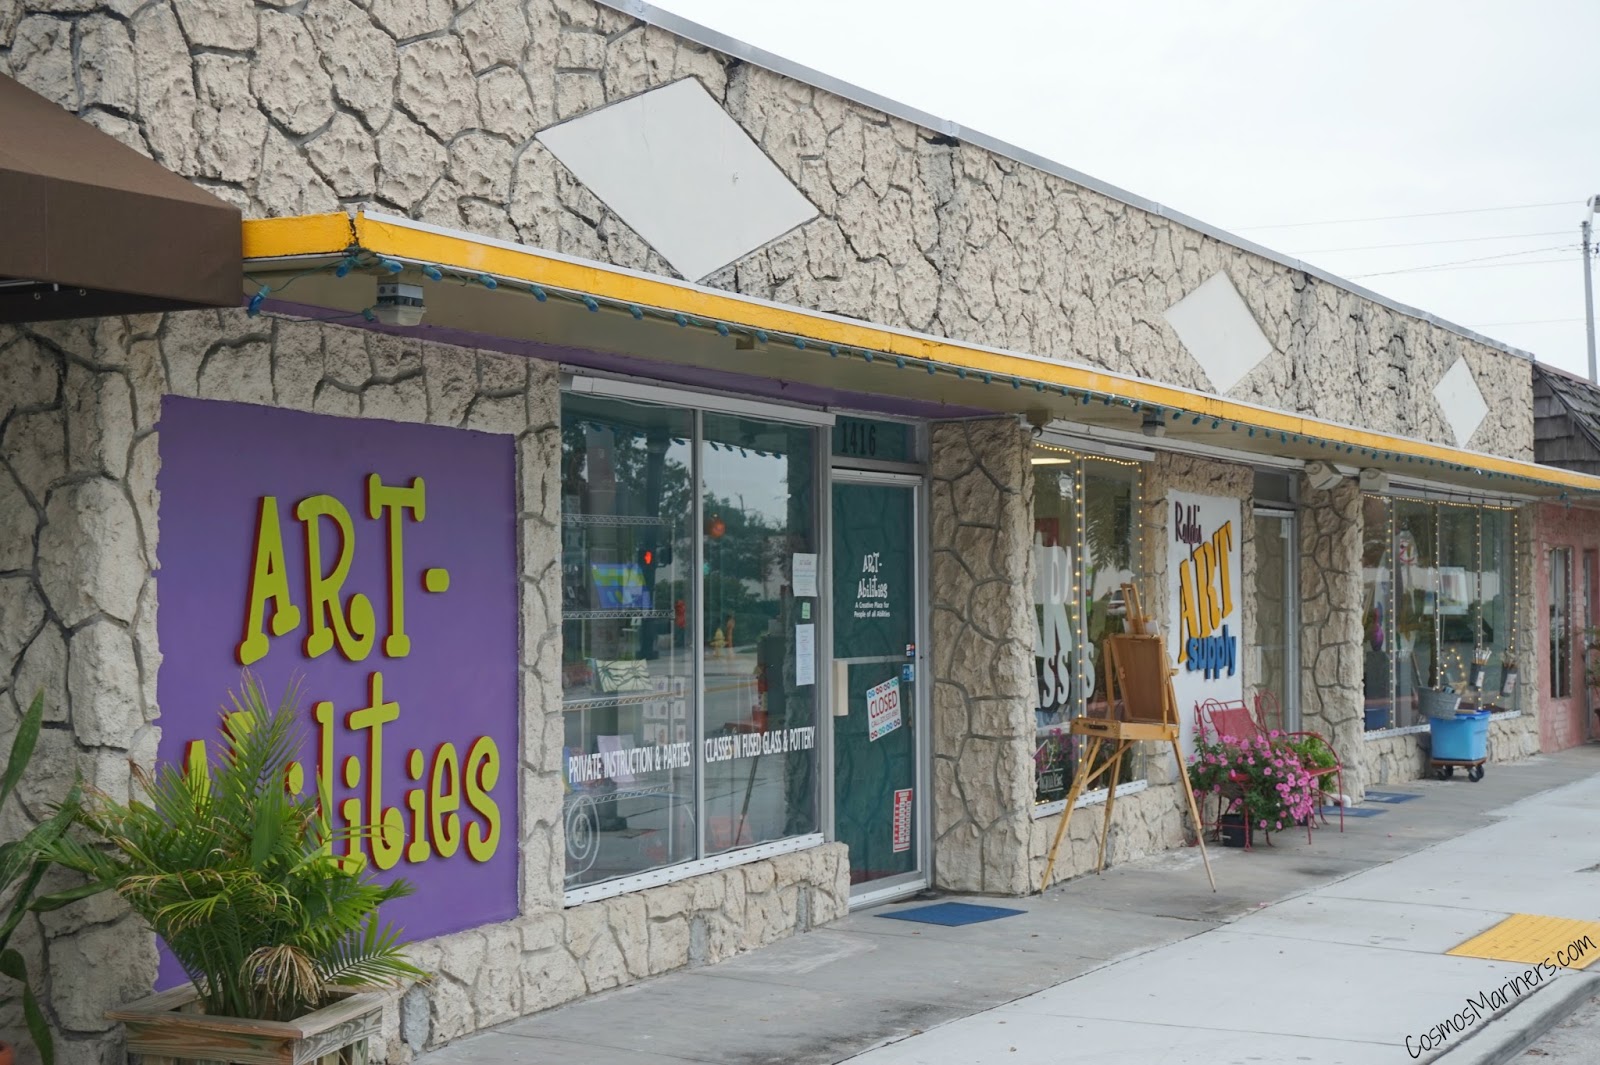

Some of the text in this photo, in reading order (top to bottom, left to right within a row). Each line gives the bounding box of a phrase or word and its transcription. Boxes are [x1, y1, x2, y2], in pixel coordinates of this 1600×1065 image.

[841, 420, 876, 456] 1416
[857, 575, 888, 599] Abilities
[1177, 519, 1233, 664] ART
[853, 610, 866, 619] People
[870, 690, 898, 719] CLOSED
[568, 742, 691, 783] PRIVATE INSTRUCTION & PARTIES
[705, 726, 816, 763] CLASSES IN FUSED GLASS & POTTERY
